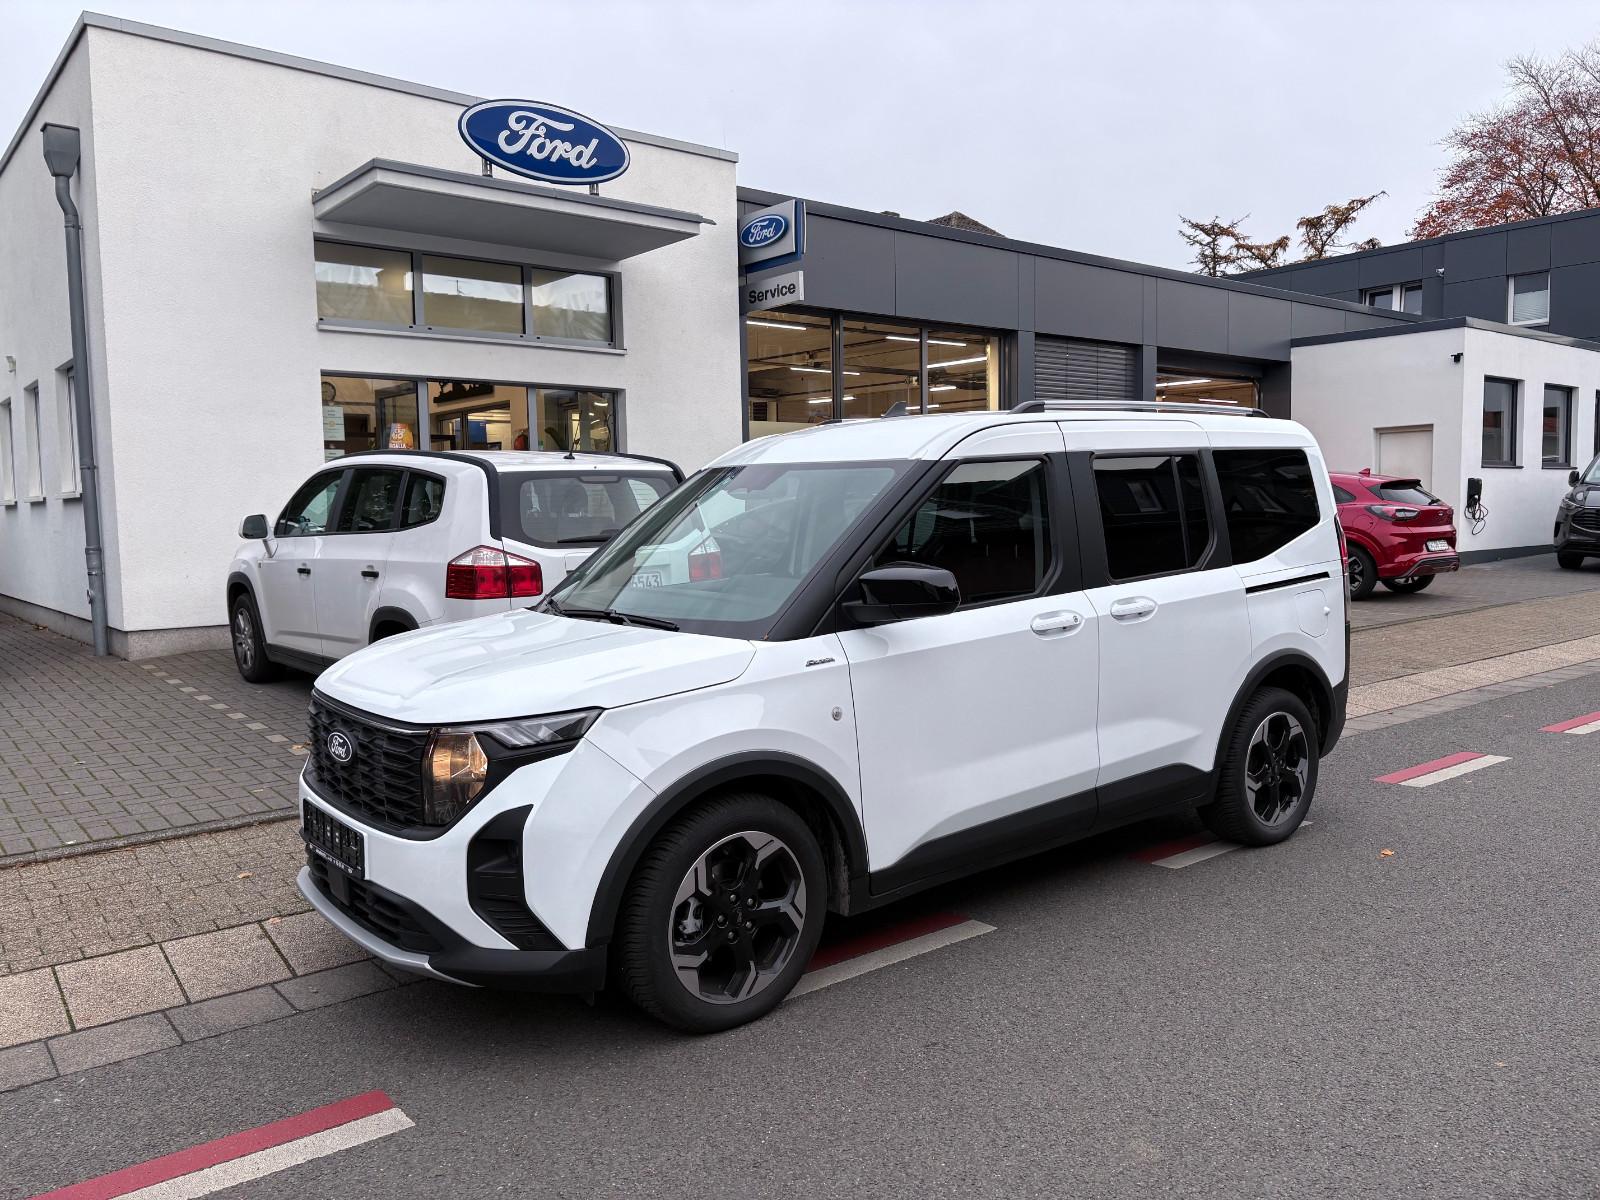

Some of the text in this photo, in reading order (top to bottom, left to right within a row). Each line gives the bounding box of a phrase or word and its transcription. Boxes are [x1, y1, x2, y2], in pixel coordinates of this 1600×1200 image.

[498, 110, 599, 169] Ford
[748, 220, 776, 243] Ford
[748, 283, 797, 304] Service
[330, 735, 347, 758] Ford
